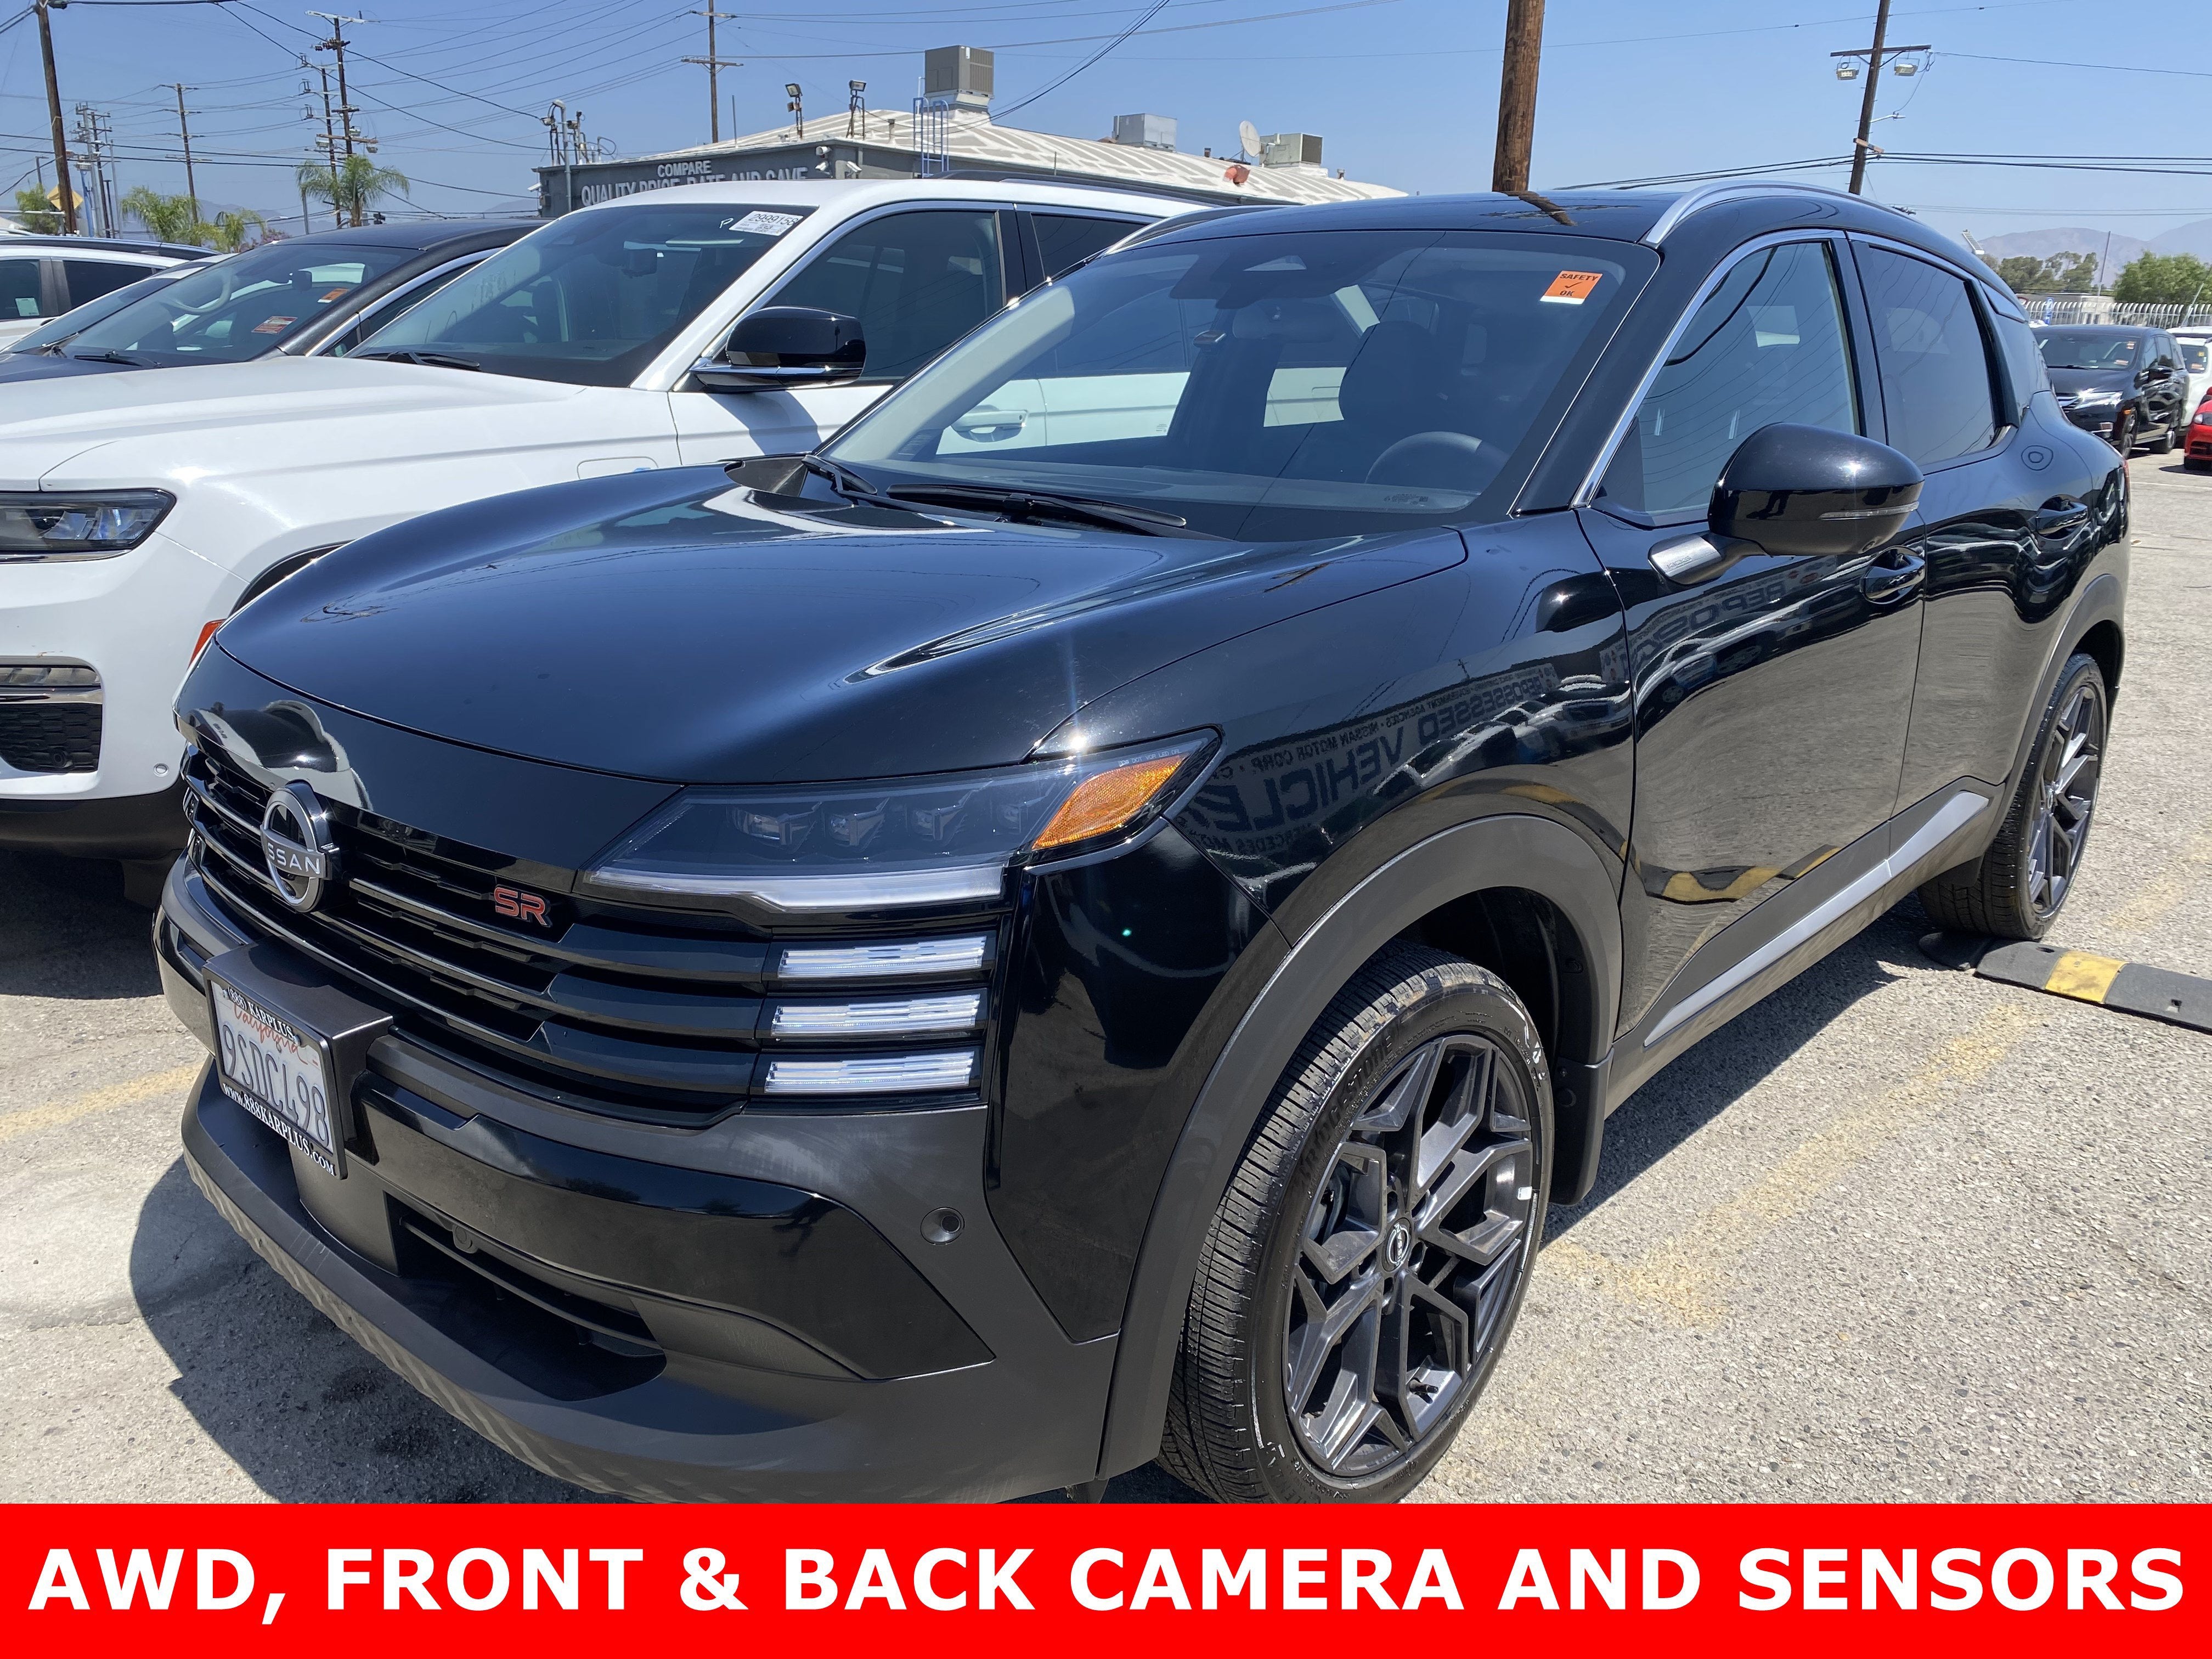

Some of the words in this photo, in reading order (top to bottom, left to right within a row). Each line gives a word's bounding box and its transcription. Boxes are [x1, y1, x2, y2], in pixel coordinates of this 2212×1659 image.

[657, 160, 712, 178] COMPARE
[748, 213, 799, 225] 2999158
[1666, 555, 1692, 569] KICKS
[494, 885, 550, 927] SR
[228, 986, 248, 1010] (888)
[247, 1001, 295, 1040] KARPLUS
[223, 1024, 329, 1147] 9SDC498
